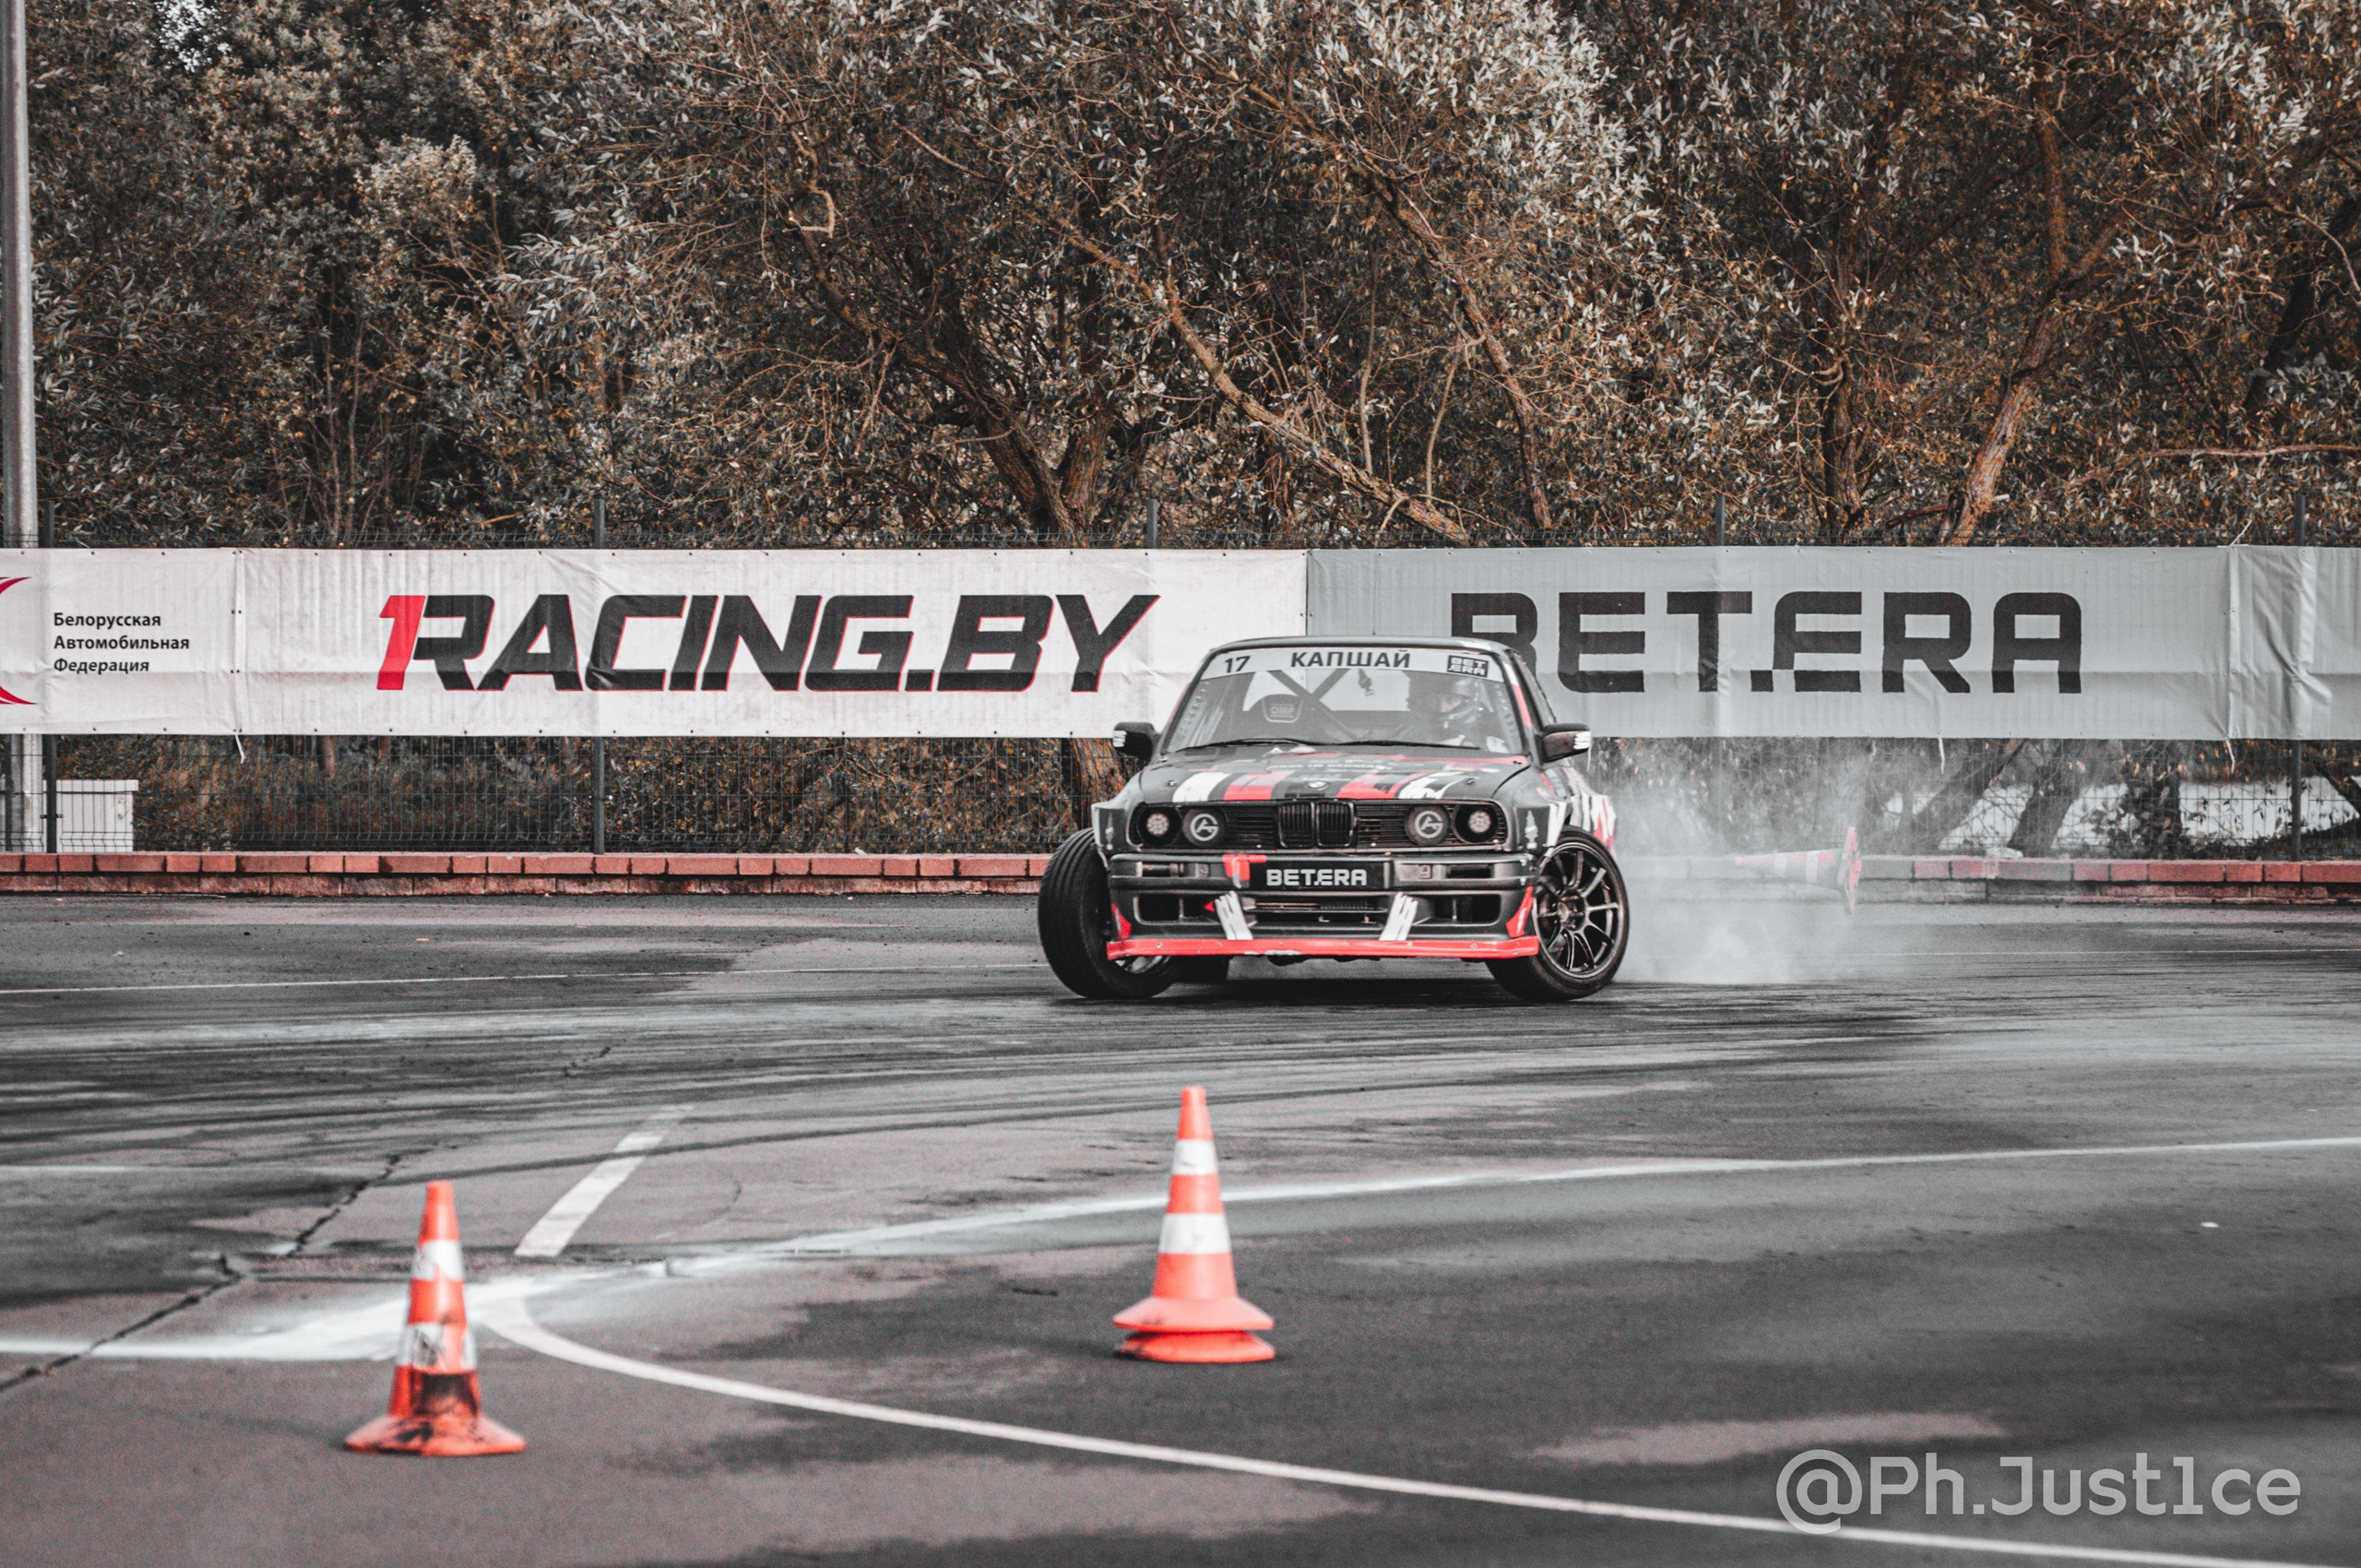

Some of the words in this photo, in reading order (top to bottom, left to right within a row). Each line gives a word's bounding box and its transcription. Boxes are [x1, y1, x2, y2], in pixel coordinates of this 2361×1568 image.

[53, 612, 161, 630] Белорусская
[53, 635, 190, 649] Автомобильная
[376, 595, 1161, 692] 1RACING.BY
[53, 658, 149, 675] Федерация
[1225, 655, 1252, 673] 17
[1291, 648, 1411, 668] КАПШАЙ
[1451, 657, 1487, 669] BET
